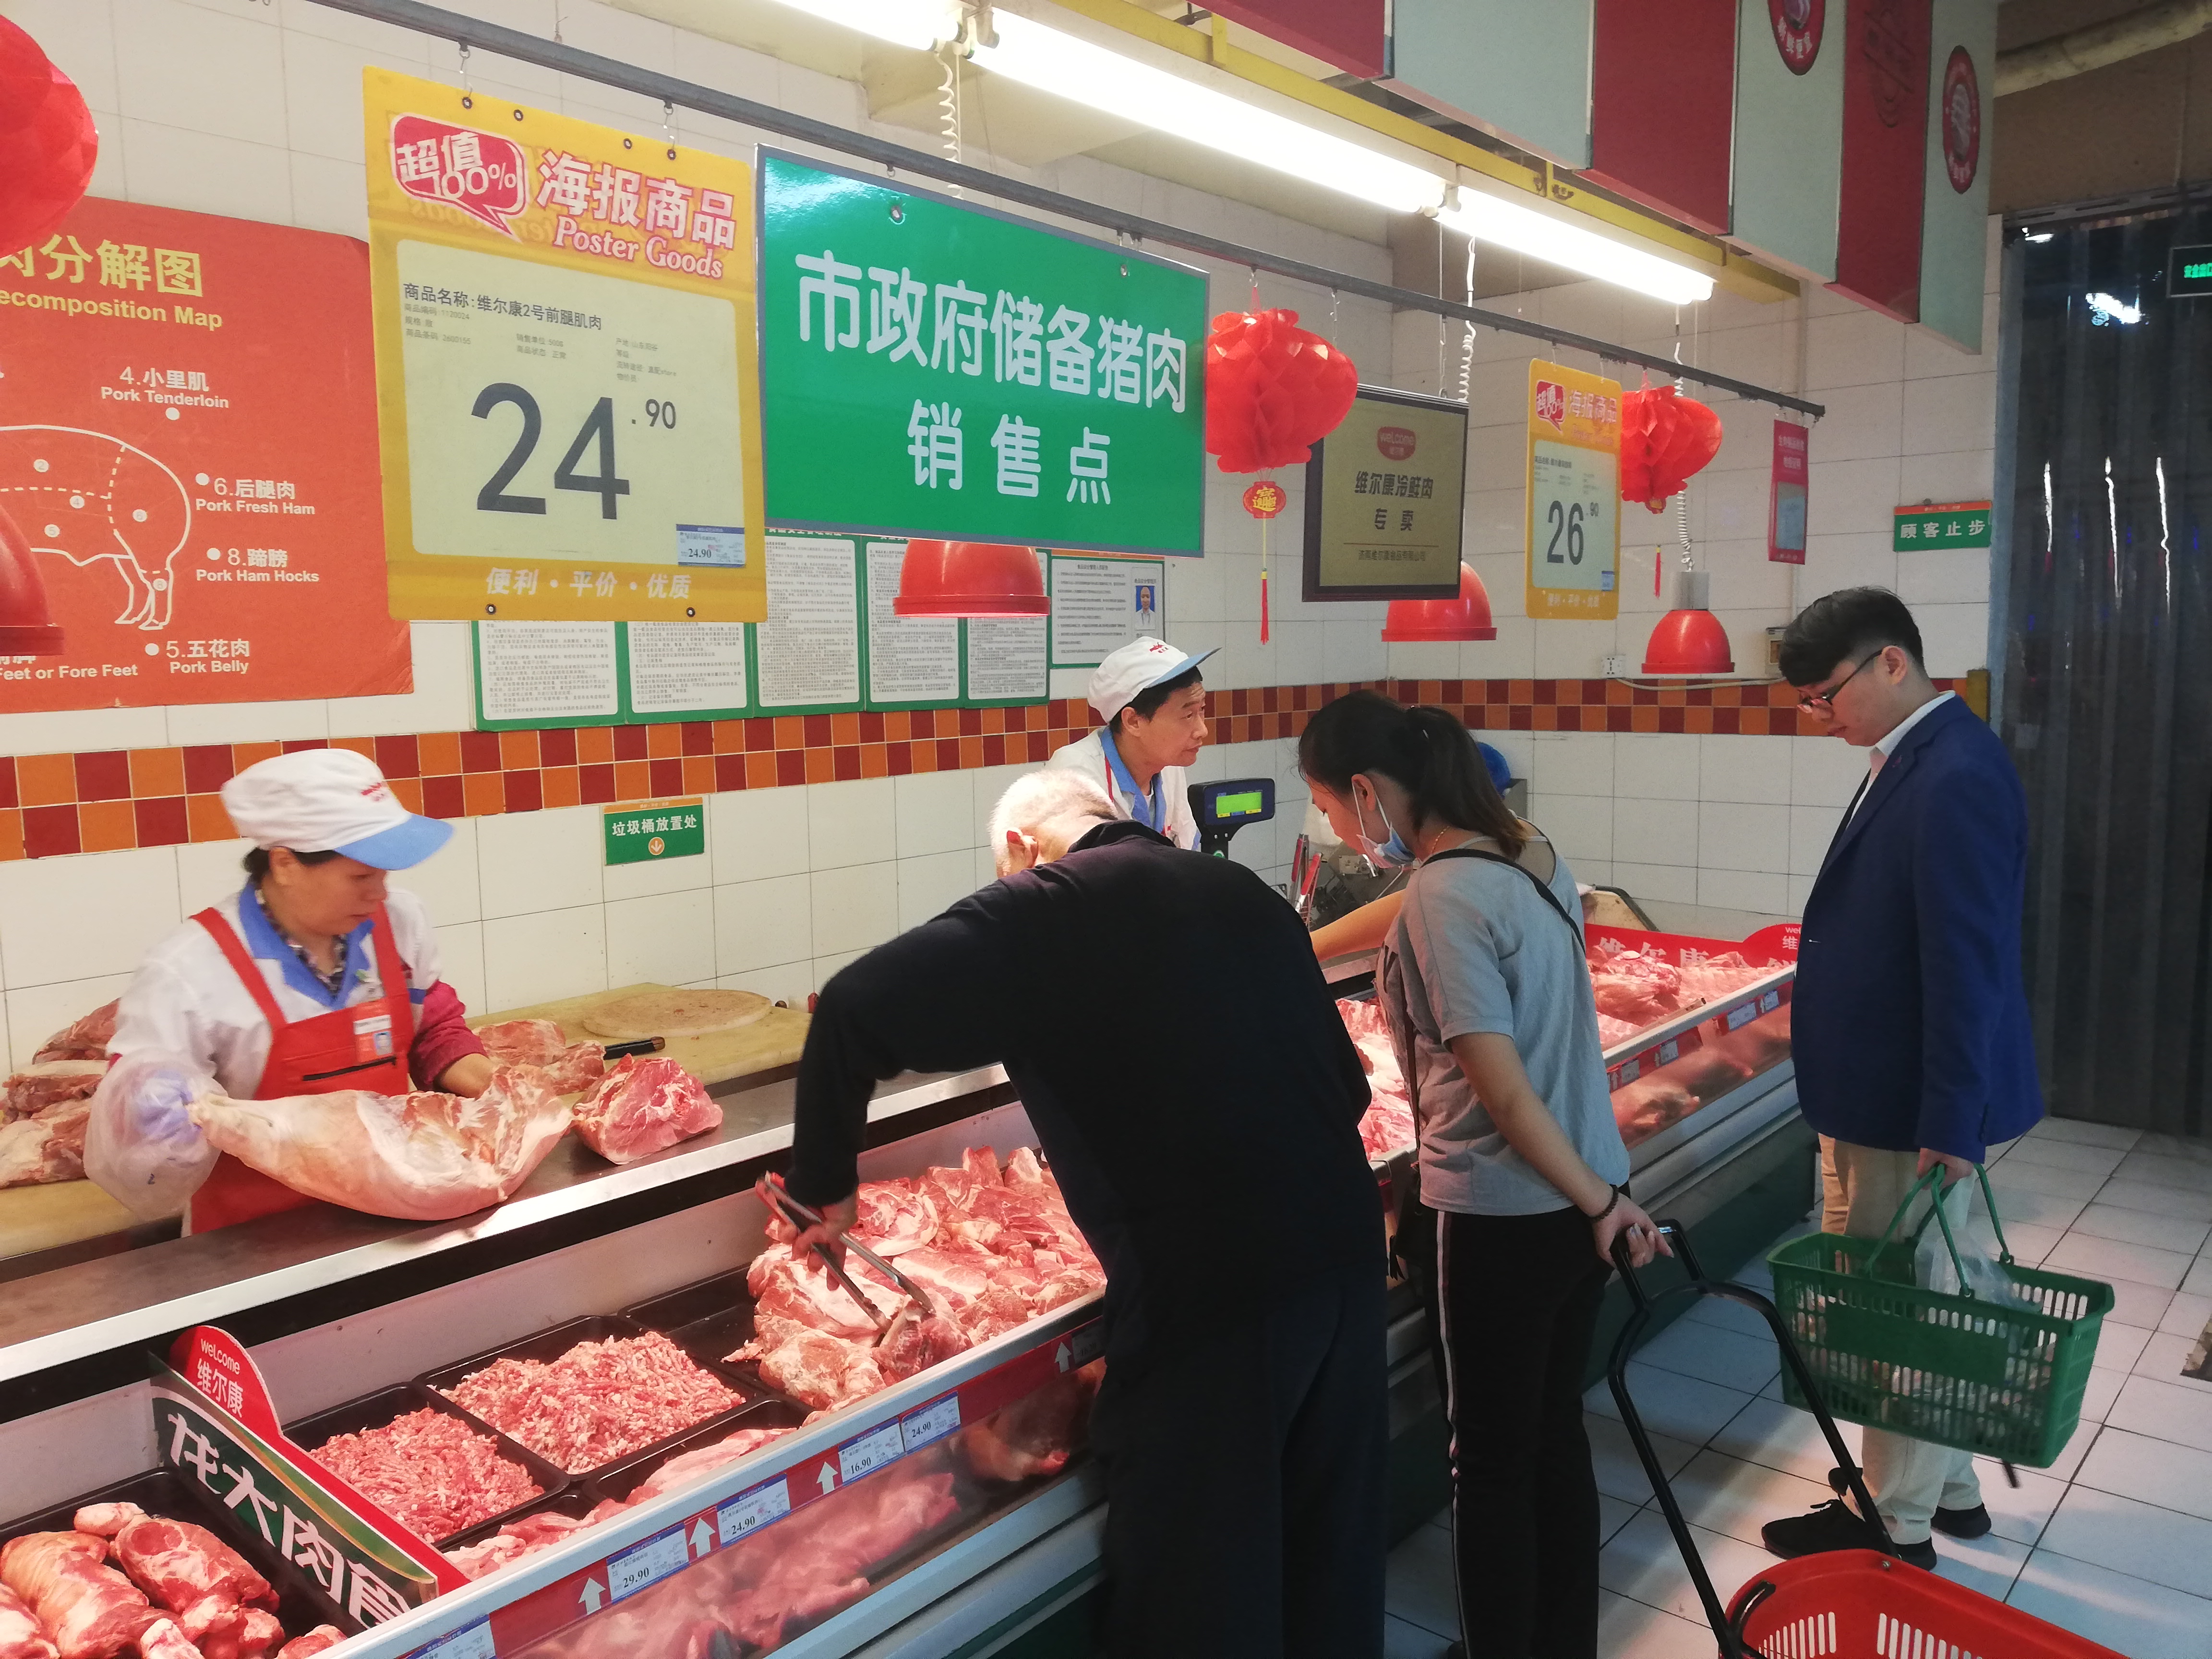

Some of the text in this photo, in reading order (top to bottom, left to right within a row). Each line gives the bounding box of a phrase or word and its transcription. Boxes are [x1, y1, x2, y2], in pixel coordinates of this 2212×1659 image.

[538, 150, 735, 250] 海报商品
[553, 216, 639, 263] Poster
[645, 235, 723, 278] Goods
[174, 306, 222, 331] Map
[794, 250, 1187, 413] 市政府储备猪肉
[120, 366, 209, 392] 4.小里肌
[101, 386, 228, 408] Pork Tenderloin
[214, 478, 295, 499] 6.后腿肉
[196, 499, 315, 515] Pork Fresh Ham
[1900, 519, 1985, 539] 顾客止步
[688, 548, 711, 558] 24.90
[196, 569, 319, 582] Pork Ham Hocks
[166, 639, 250, 658] 5.五花肉
[36, 669, 54, 679] or
[59, 665, 97, 678] Fore
[102, 664, 138, 676] Feet
[170, 660, 249, 674] Pork Belly
[612, 814, 697, 836] 垃圾桶放置处
[201, 1338, 240, 1375] welcome
[197, 1358, 243, 1418] 维尔康
[912, 1421, 931, 1438] 24.90
[851, 1457, 871, 1475] 16.90
[731, 1515, 755, 1535] 24.90
[623, 1567, 649, 1588] 29.90
